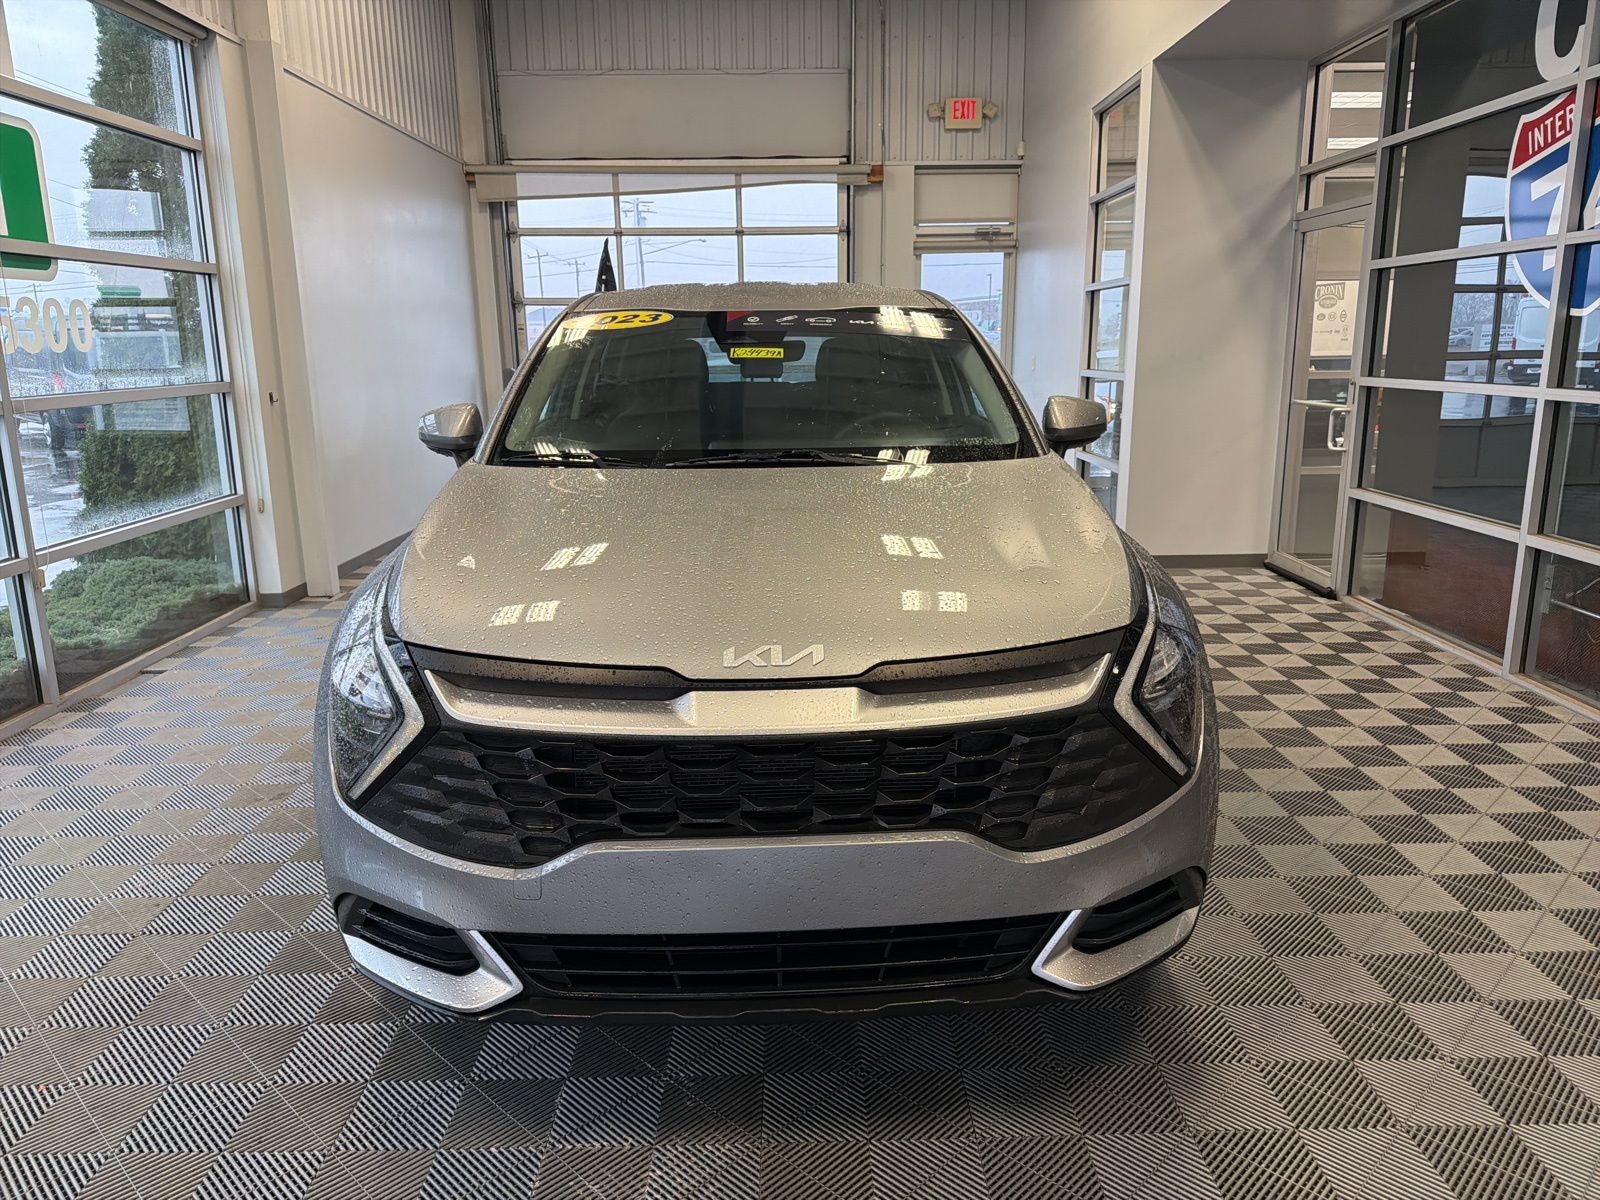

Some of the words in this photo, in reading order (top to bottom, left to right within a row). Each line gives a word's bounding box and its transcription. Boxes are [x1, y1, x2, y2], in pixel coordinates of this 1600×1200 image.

[953, 99, 977, 120] EXIT
[1315, 283, 1344, 300] CRONIN
[722, 644, 825, 668] KIA
